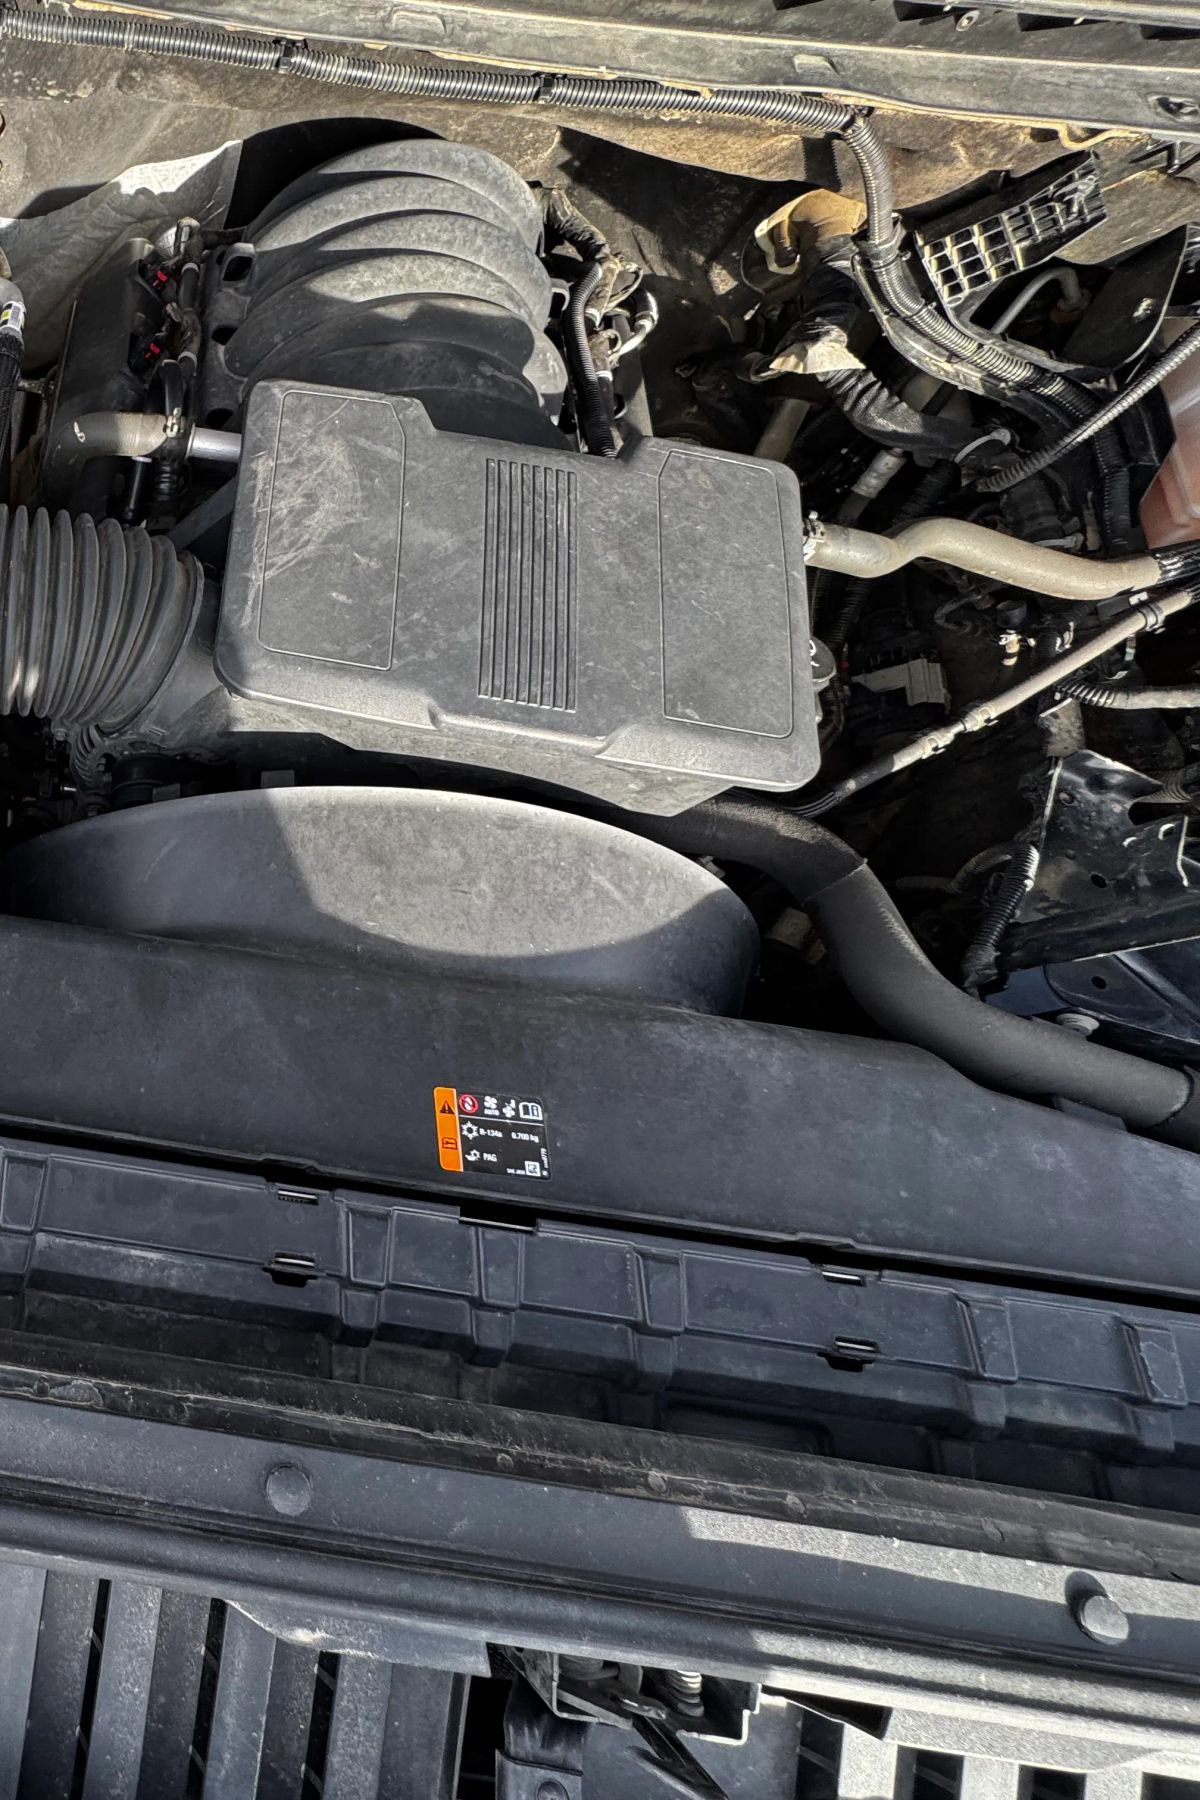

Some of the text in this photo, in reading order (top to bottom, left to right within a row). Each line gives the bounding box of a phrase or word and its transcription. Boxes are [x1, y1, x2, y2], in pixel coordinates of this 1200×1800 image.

[479, 1128, 540, 1143] R-134a 0.700 kg
[483, 1152, 498, 1162] PAG
